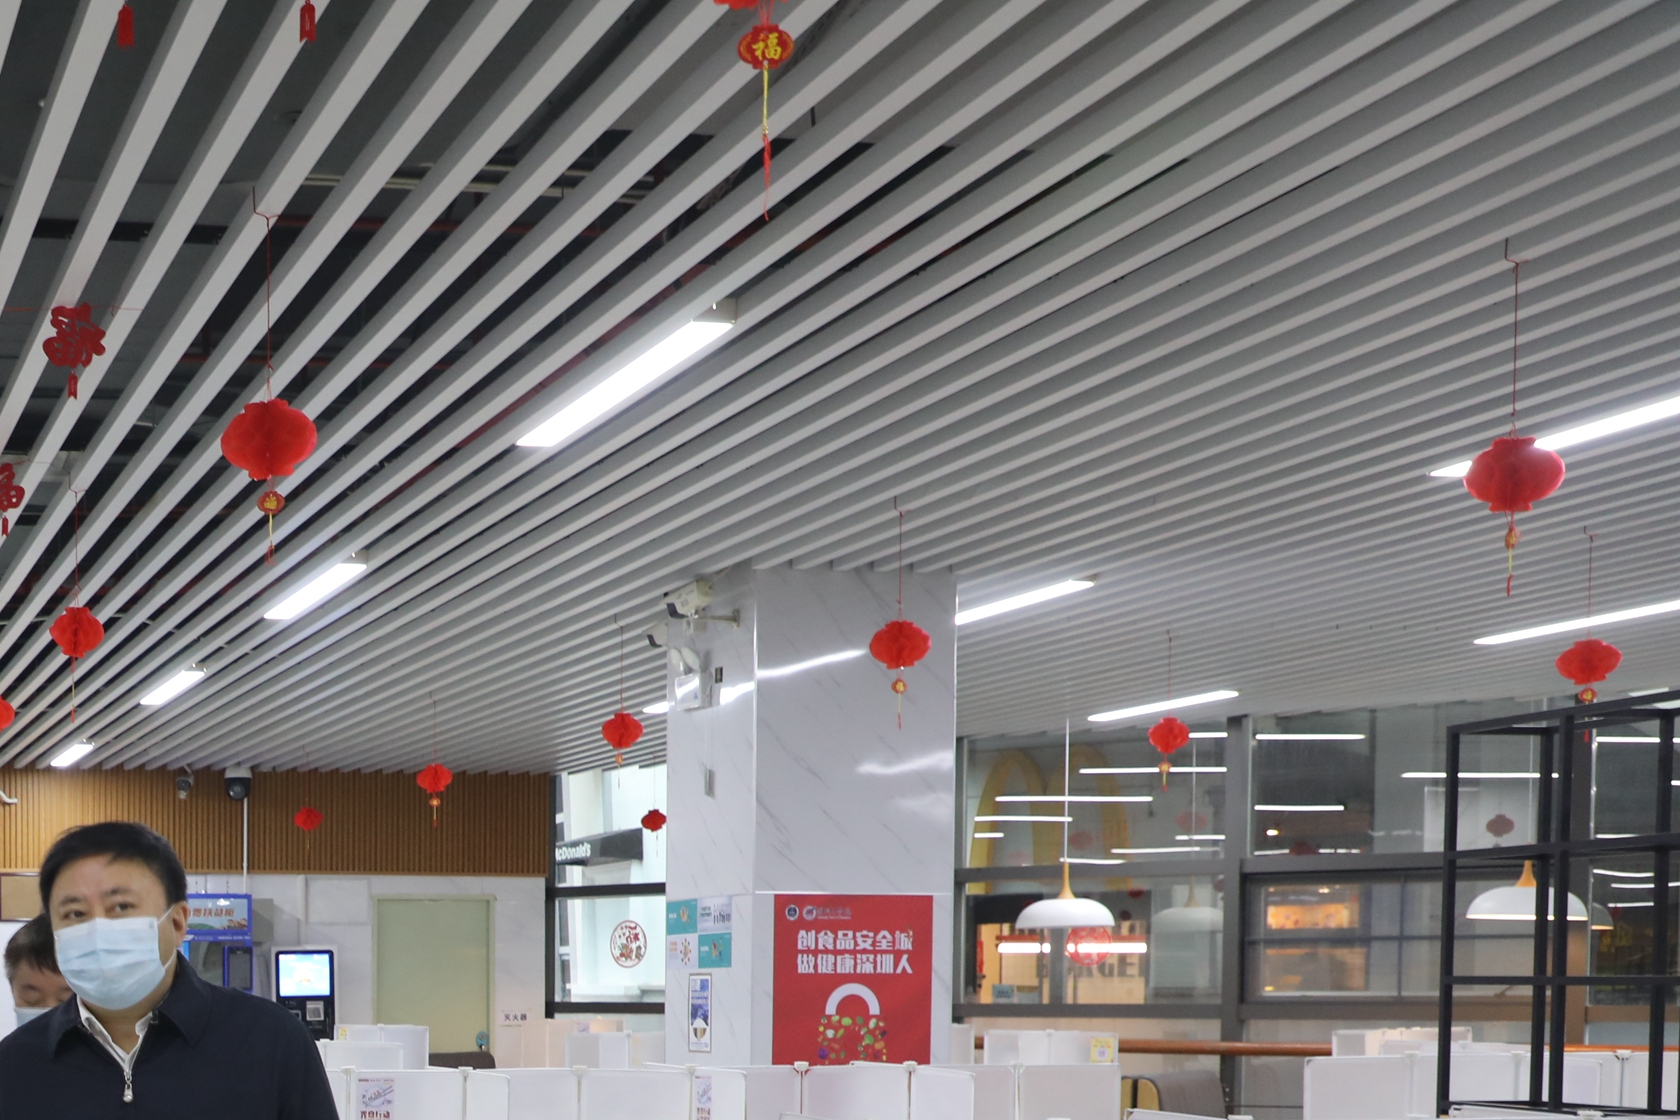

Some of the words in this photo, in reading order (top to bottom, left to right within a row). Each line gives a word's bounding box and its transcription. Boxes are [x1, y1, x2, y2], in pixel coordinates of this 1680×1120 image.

[751, 32, 783, 61] 福
[797, 929, 913, 951] 创食品安全城
[797, 953, 913, 974] 做健康深圳人
[504, 1013, 527, 1021] 灭火器
